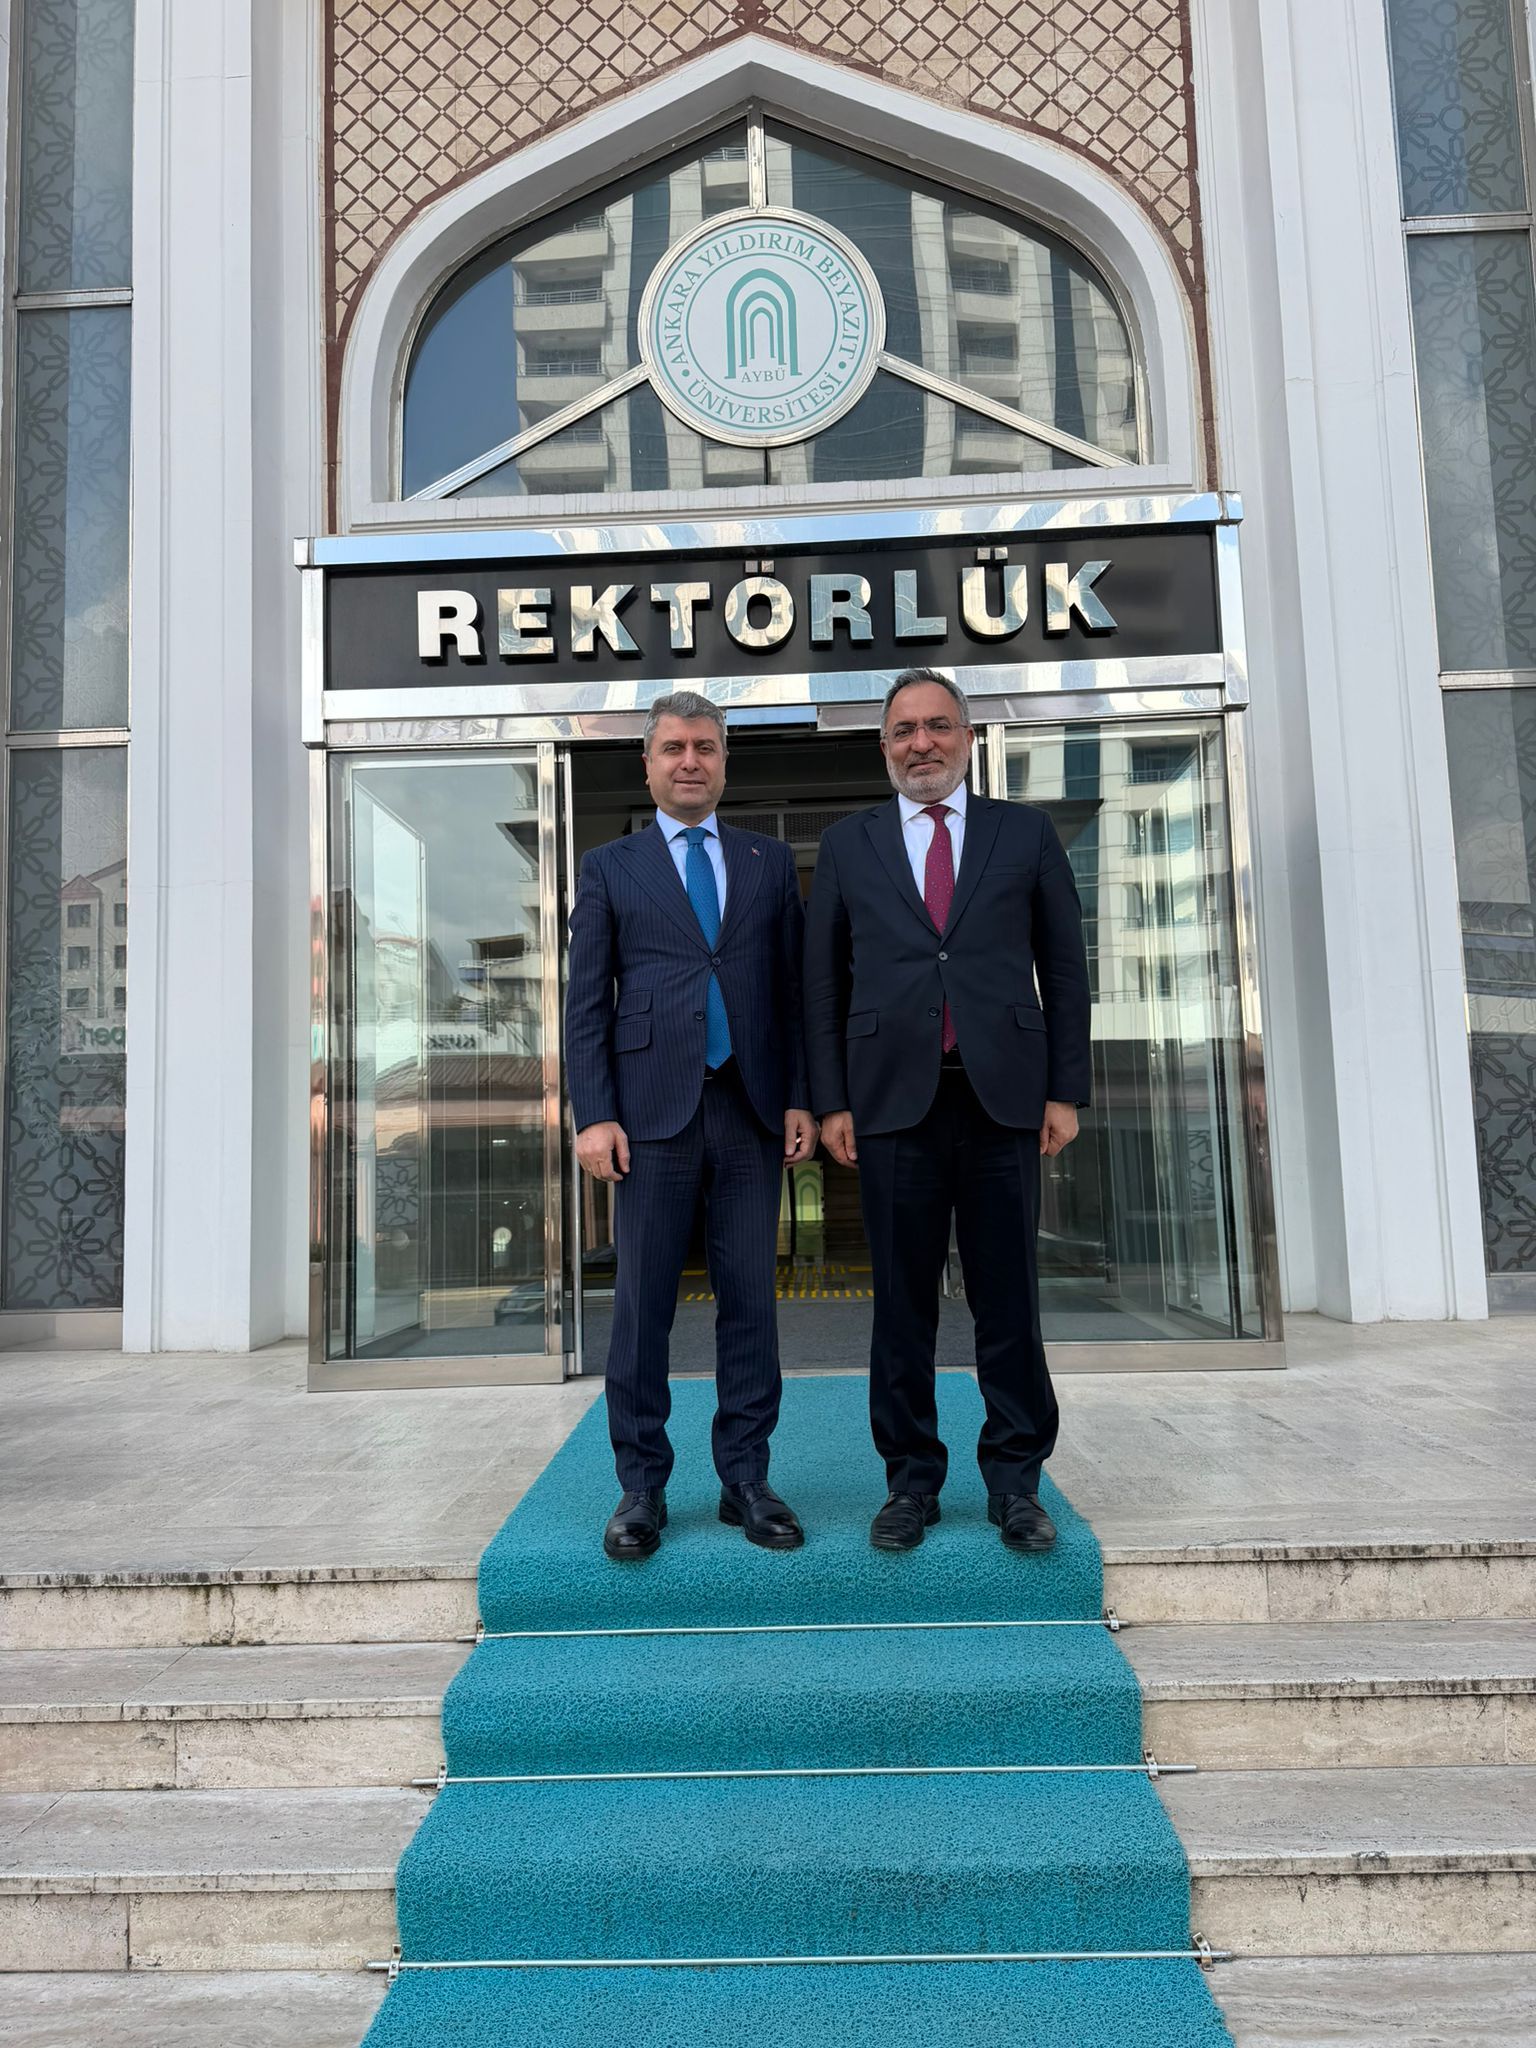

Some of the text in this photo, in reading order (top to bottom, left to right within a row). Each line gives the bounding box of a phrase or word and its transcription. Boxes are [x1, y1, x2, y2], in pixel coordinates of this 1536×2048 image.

[664, 232, 861, 365] ANKARA YILDIRIM BEYAZIT
[687, 371, 843, 424] ÜNİVERSİTESİ
[741, 367, 786, 383] AYBÜ
[417, 547, 1118, 659] REKTÖRLÜK
